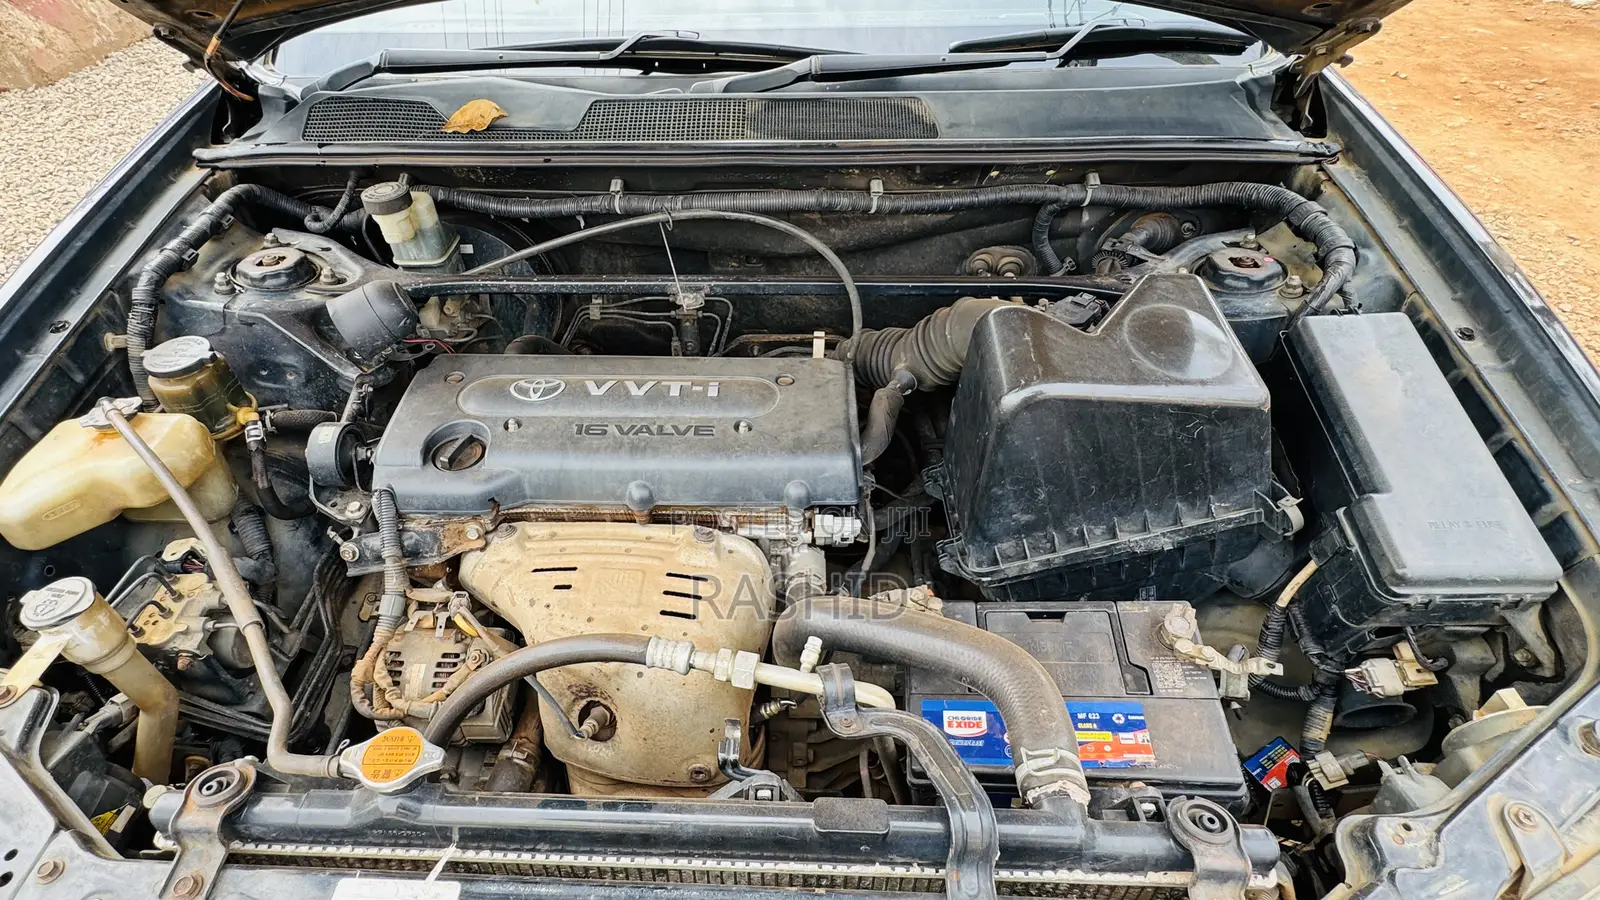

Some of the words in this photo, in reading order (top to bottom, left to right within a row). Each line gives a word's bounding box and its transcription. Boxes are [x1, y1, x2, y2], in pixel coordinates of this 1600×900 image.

[584, 380, 720, 397] VVT-i
[575, 423, 609, 436] 16
[613, 423, 715, 437] VALVE
[1427, 520, 1460, 530] RELAY
[1476, 519, 1503, 529] FUSE
[947, 720, 983, 729] EXIDE
